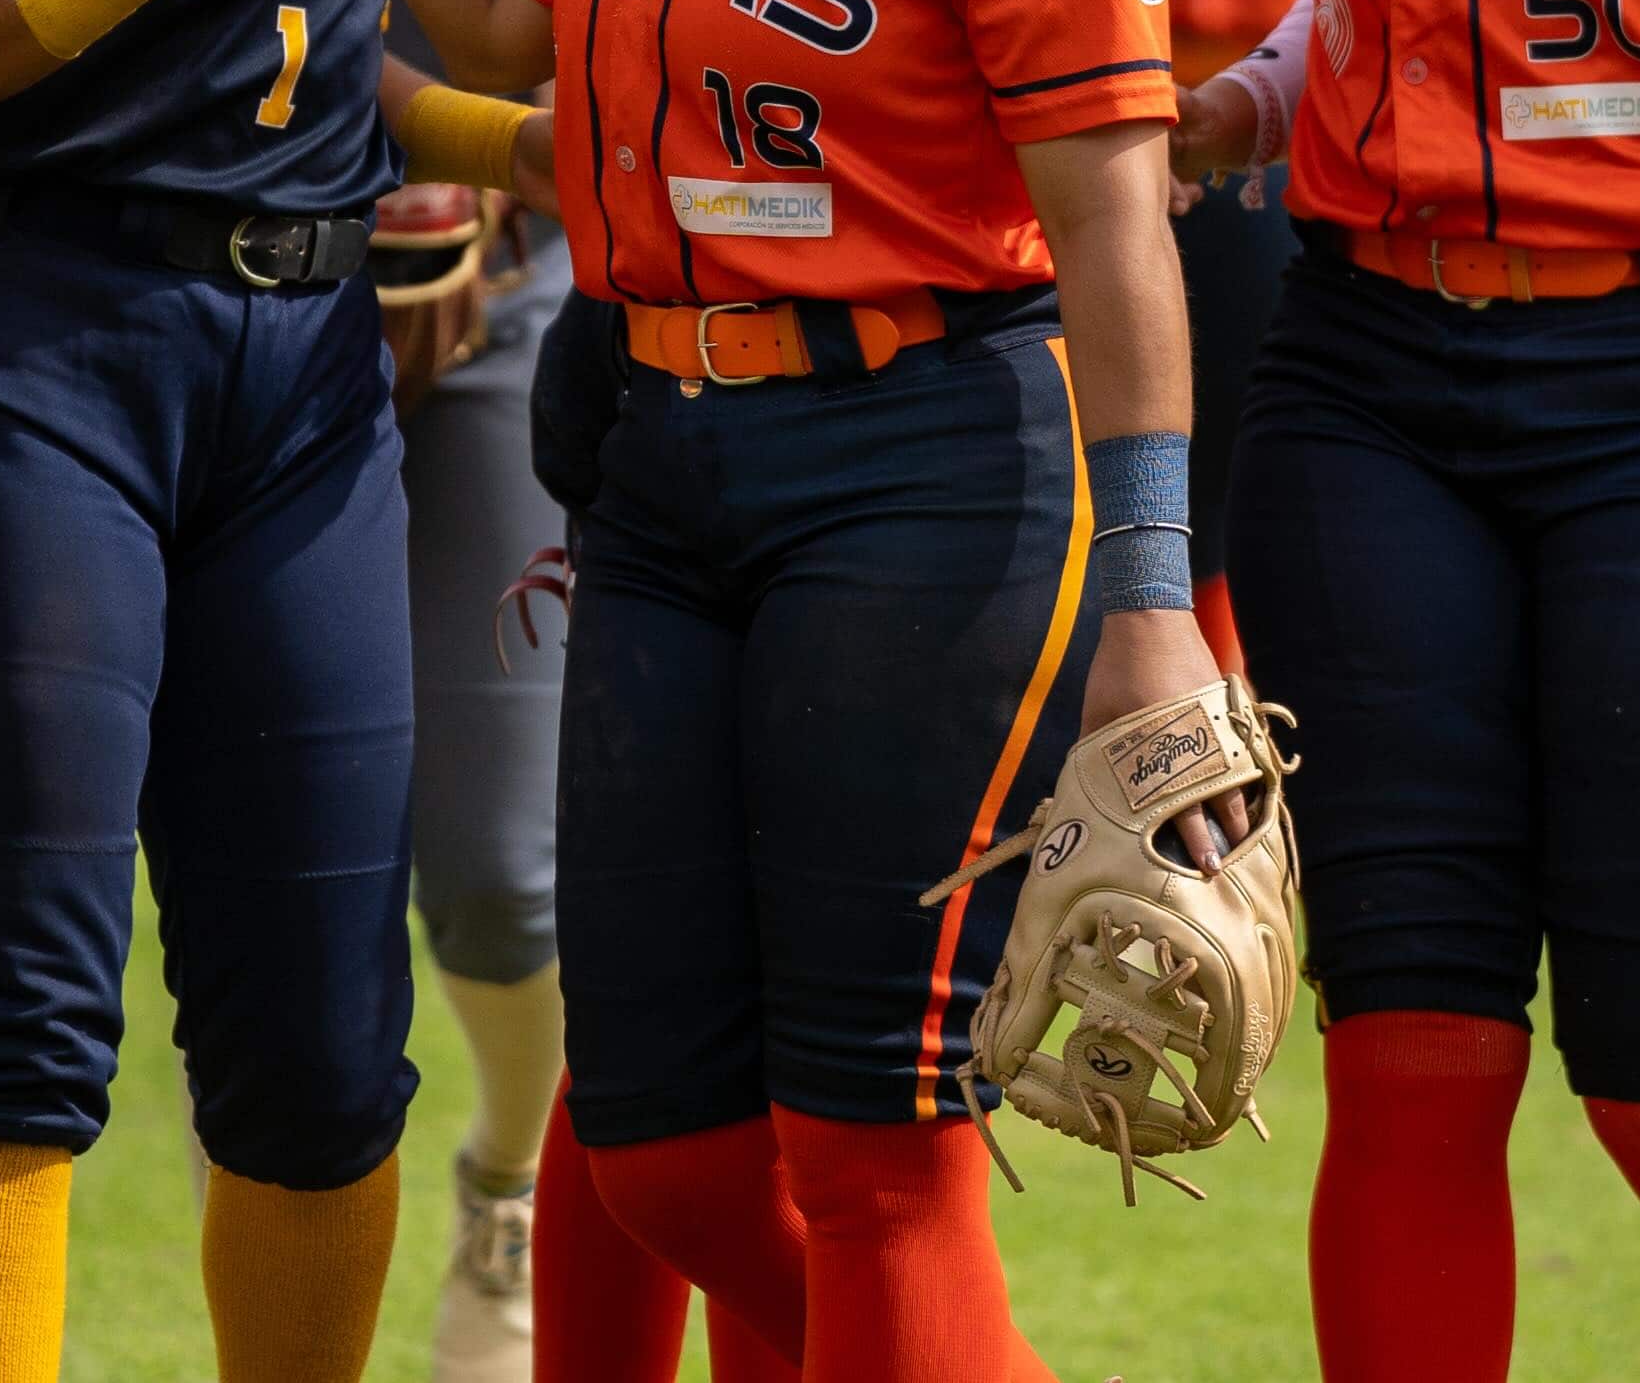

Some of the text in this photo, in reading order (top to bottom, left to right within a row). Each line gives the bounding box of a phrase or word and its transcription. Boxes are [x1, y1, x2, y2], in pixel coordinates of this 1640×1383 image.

[254, 4, 309, 130] 1
[703, 67, 823, 171] 18
[693, 191, 825, 218] HATIMEDIK
[1128, 726, 1209, 787] Rawlings
[1233, 999, 1270, 1096] Rawlings
